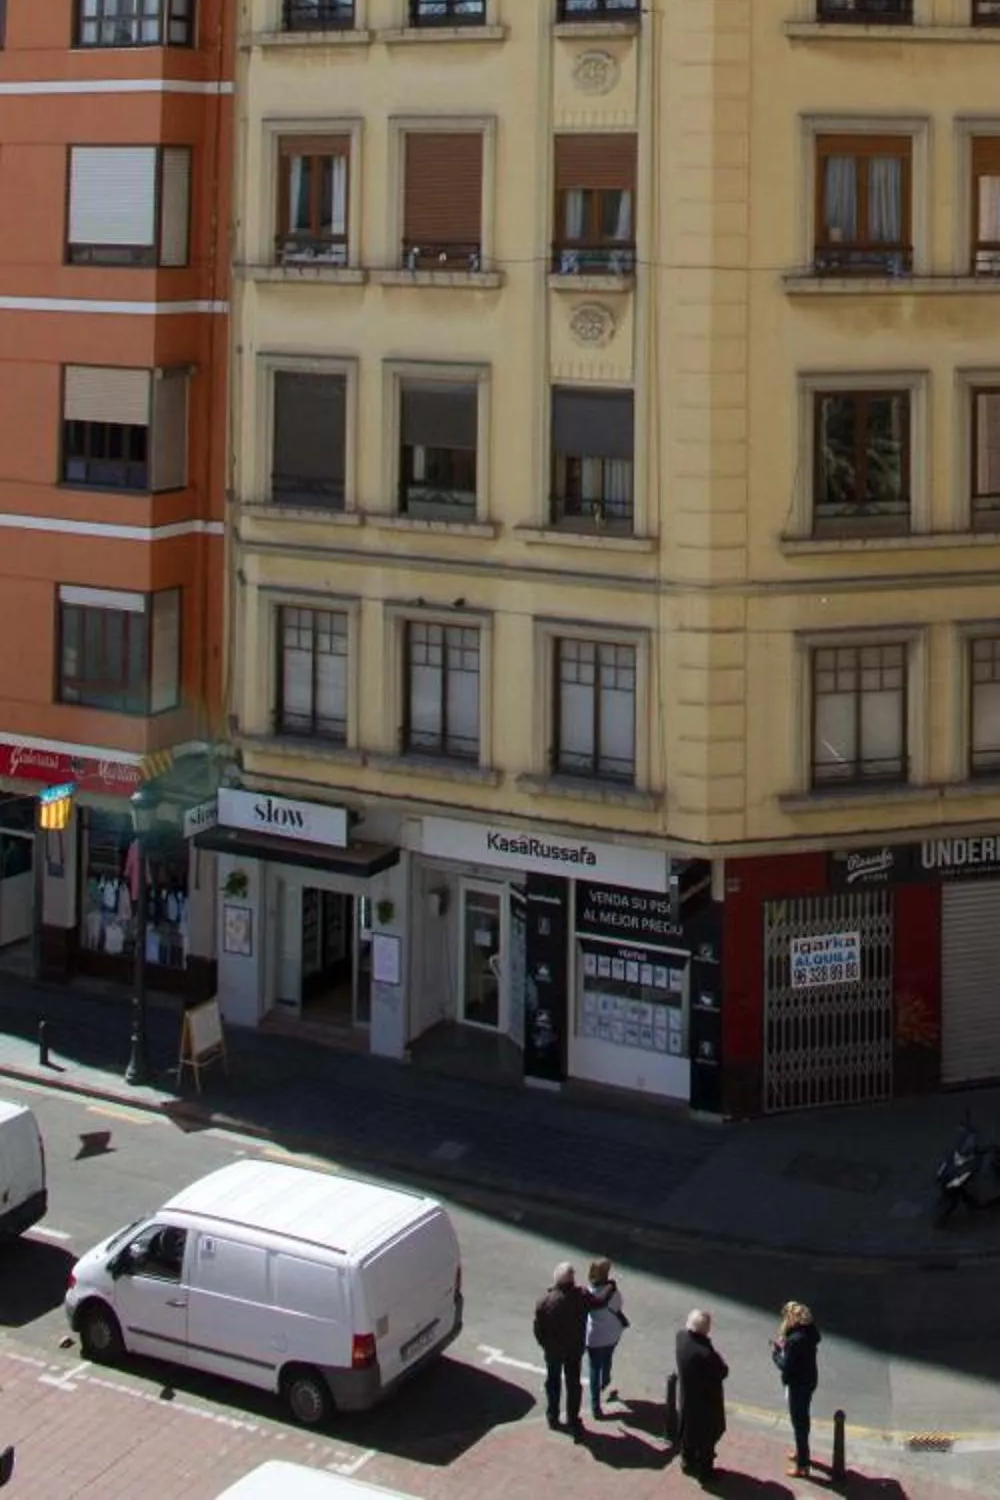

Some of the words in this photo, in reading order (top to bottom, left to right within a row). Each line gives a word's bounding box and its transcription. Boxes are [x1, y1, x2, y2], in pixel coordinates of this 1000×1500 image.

[254, 800, 304, 828] slow
[590, 889, 629, 908] VENDA
[631, 898, 647, 911] SU
[583, 907, 599, 921] AL
[601, 911, 639, 929] MEJOR
[795, 951, 857, 966] ALQUILA
